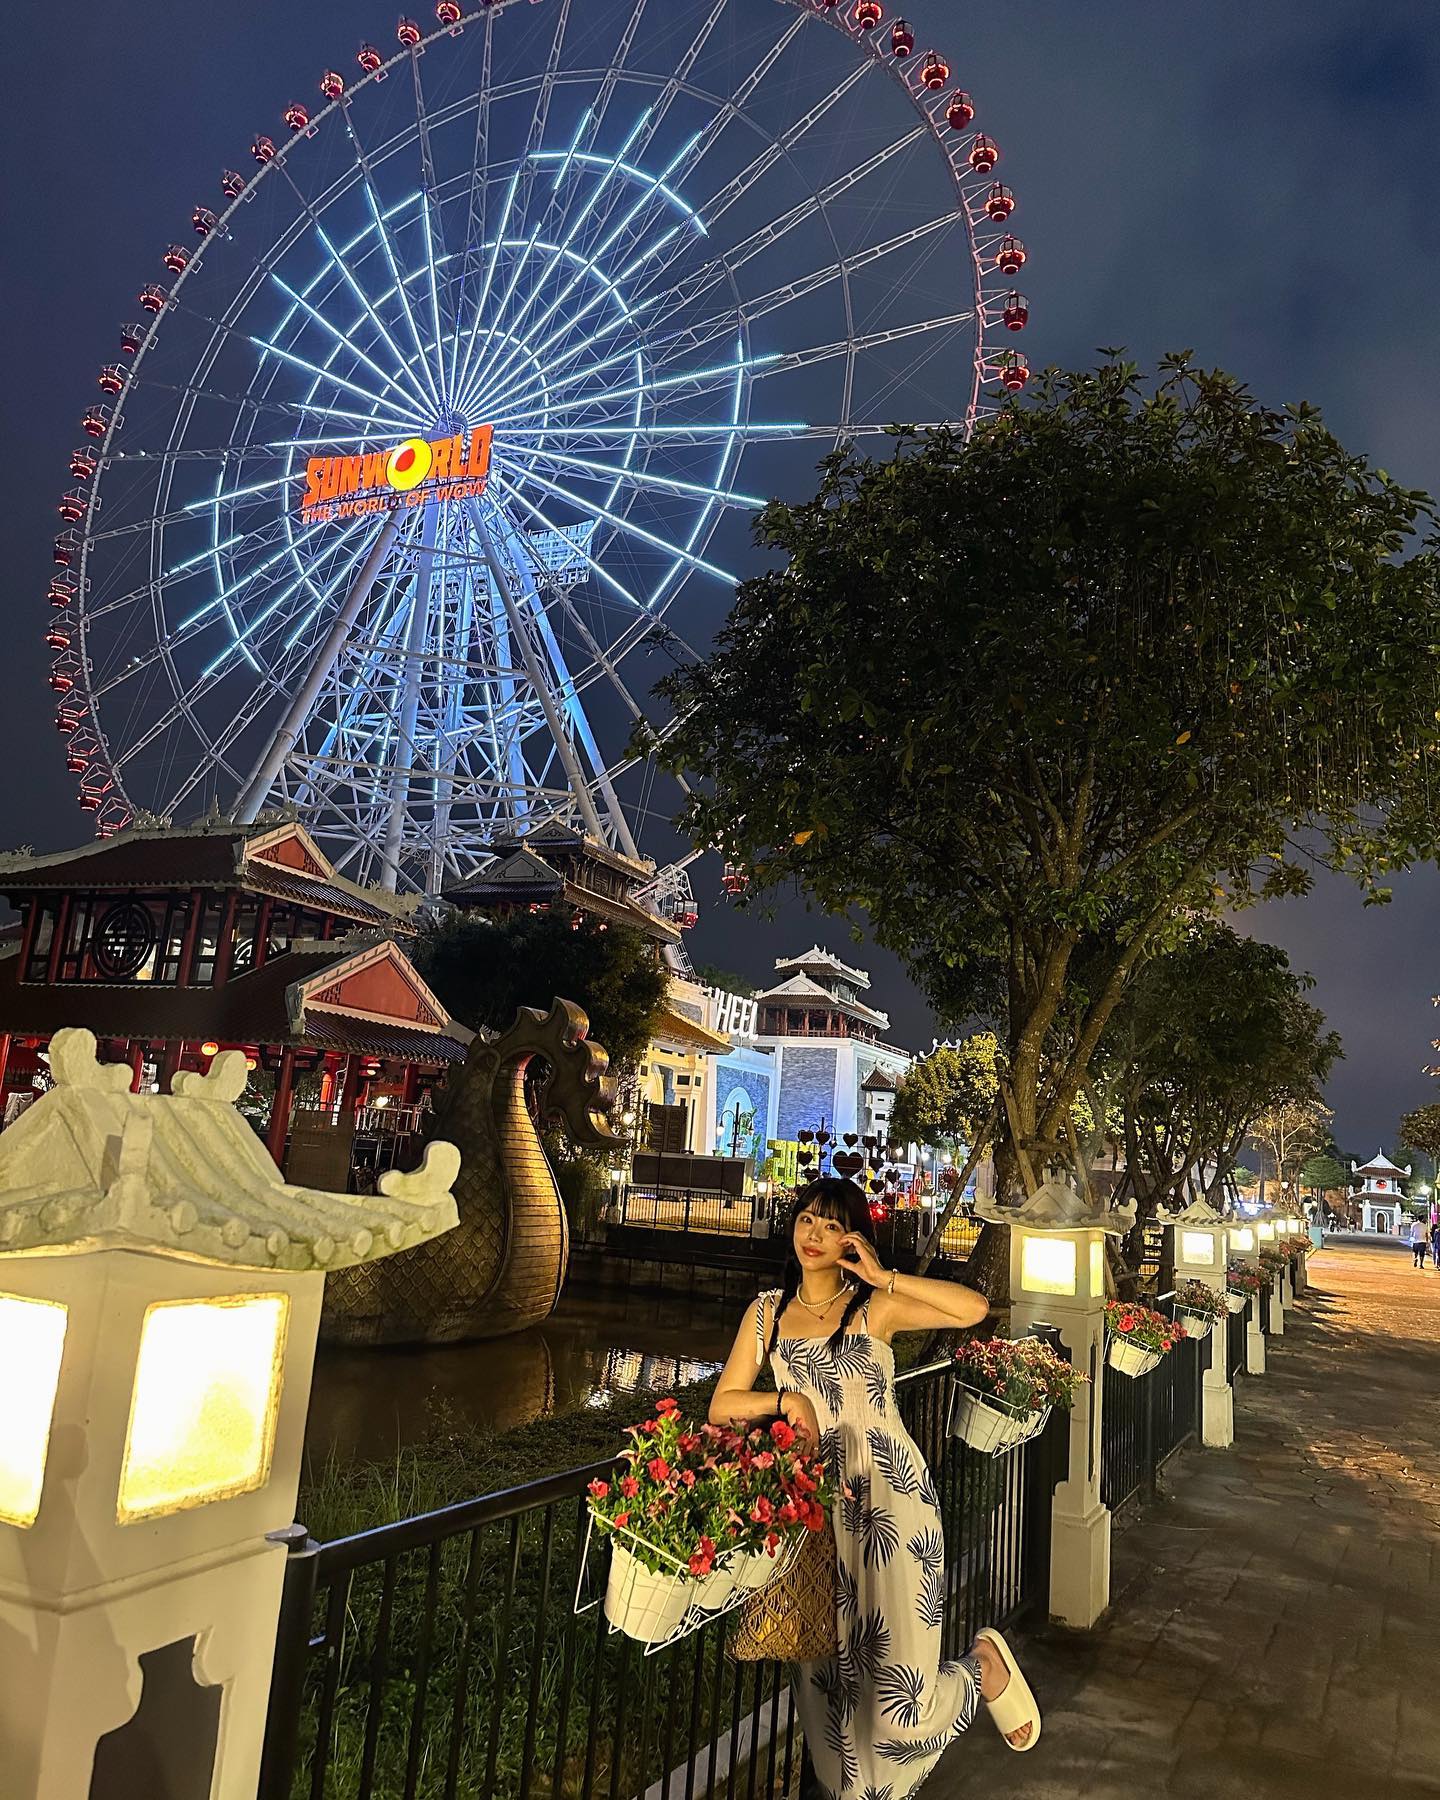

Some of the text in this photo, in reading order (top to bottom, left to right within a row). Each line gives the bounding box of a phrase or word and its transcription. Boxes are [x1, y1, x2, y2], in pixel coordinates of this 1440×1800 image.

[302, 506, 333, 524] THE
[406, 489, 431, 507] OF
[436, 479, 487, 502] WOW
